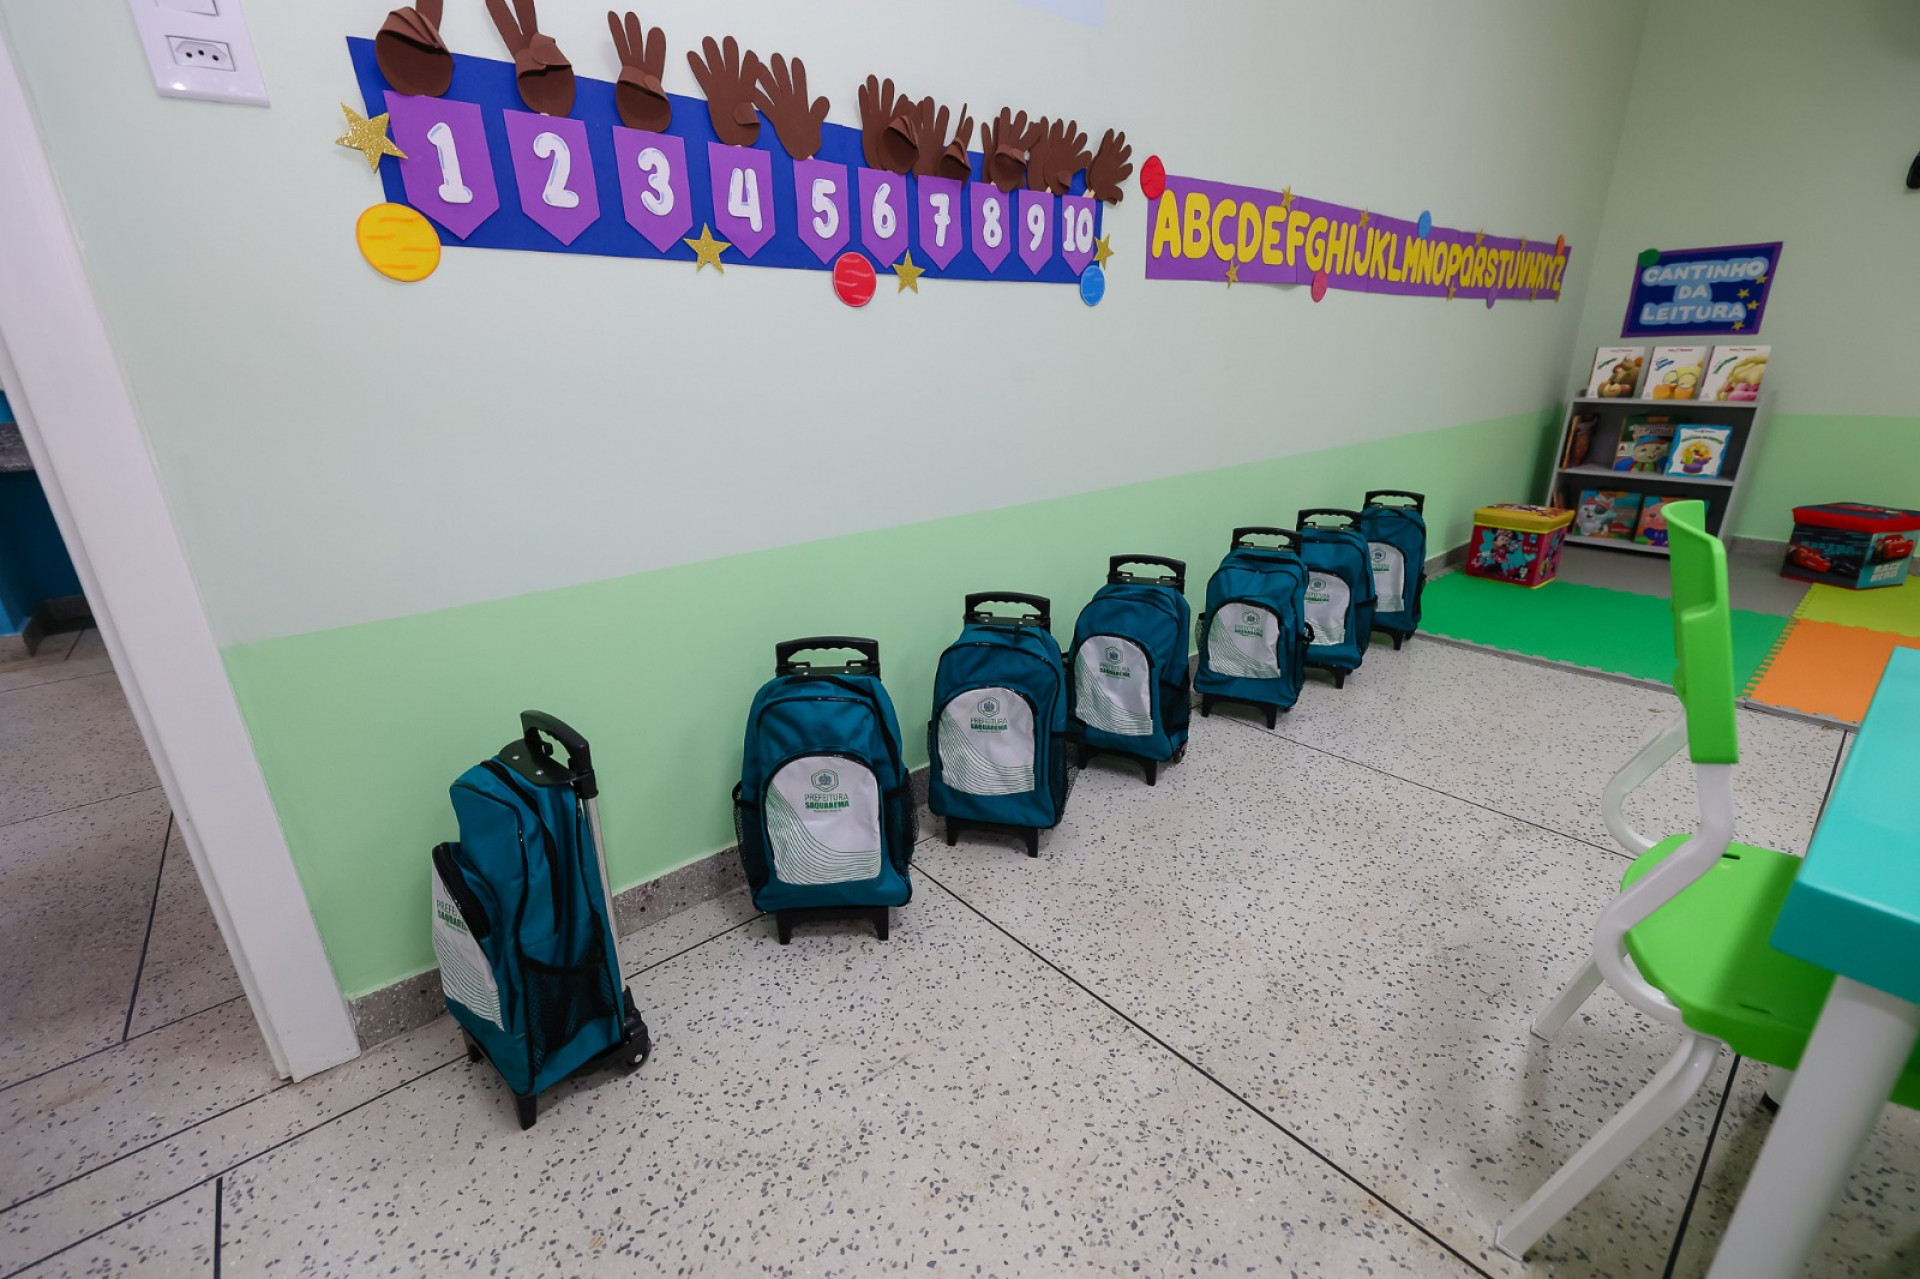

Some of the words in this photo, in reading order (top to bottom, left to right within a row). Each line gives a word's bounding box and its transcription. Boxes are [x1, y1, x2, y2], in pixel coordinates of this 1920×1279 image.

[427, 121, 473, 204] 1
[533, 131, 579, 208] 2
[638, 147, 674, 216] 3
[727, 166, 764, 233] 4
[812, 177, 840, 239] 5
[872, 182, 897, 239] 6
[930, 192, 952, 248] 7
[979, 197, 1003, 249] 8
[1026, 203, 1046, 252] 9
[1062, 204, 1095, 254] 10
[1644, 261, 1765, 283] CANTINHO
[1677, 284, 1708, 300] DA
[1643, 304, 1745, 320] LEITURA
[804, 793, 849, 801] PREFEITURA
[804, 801, 850, 810] SAQUAREMA
